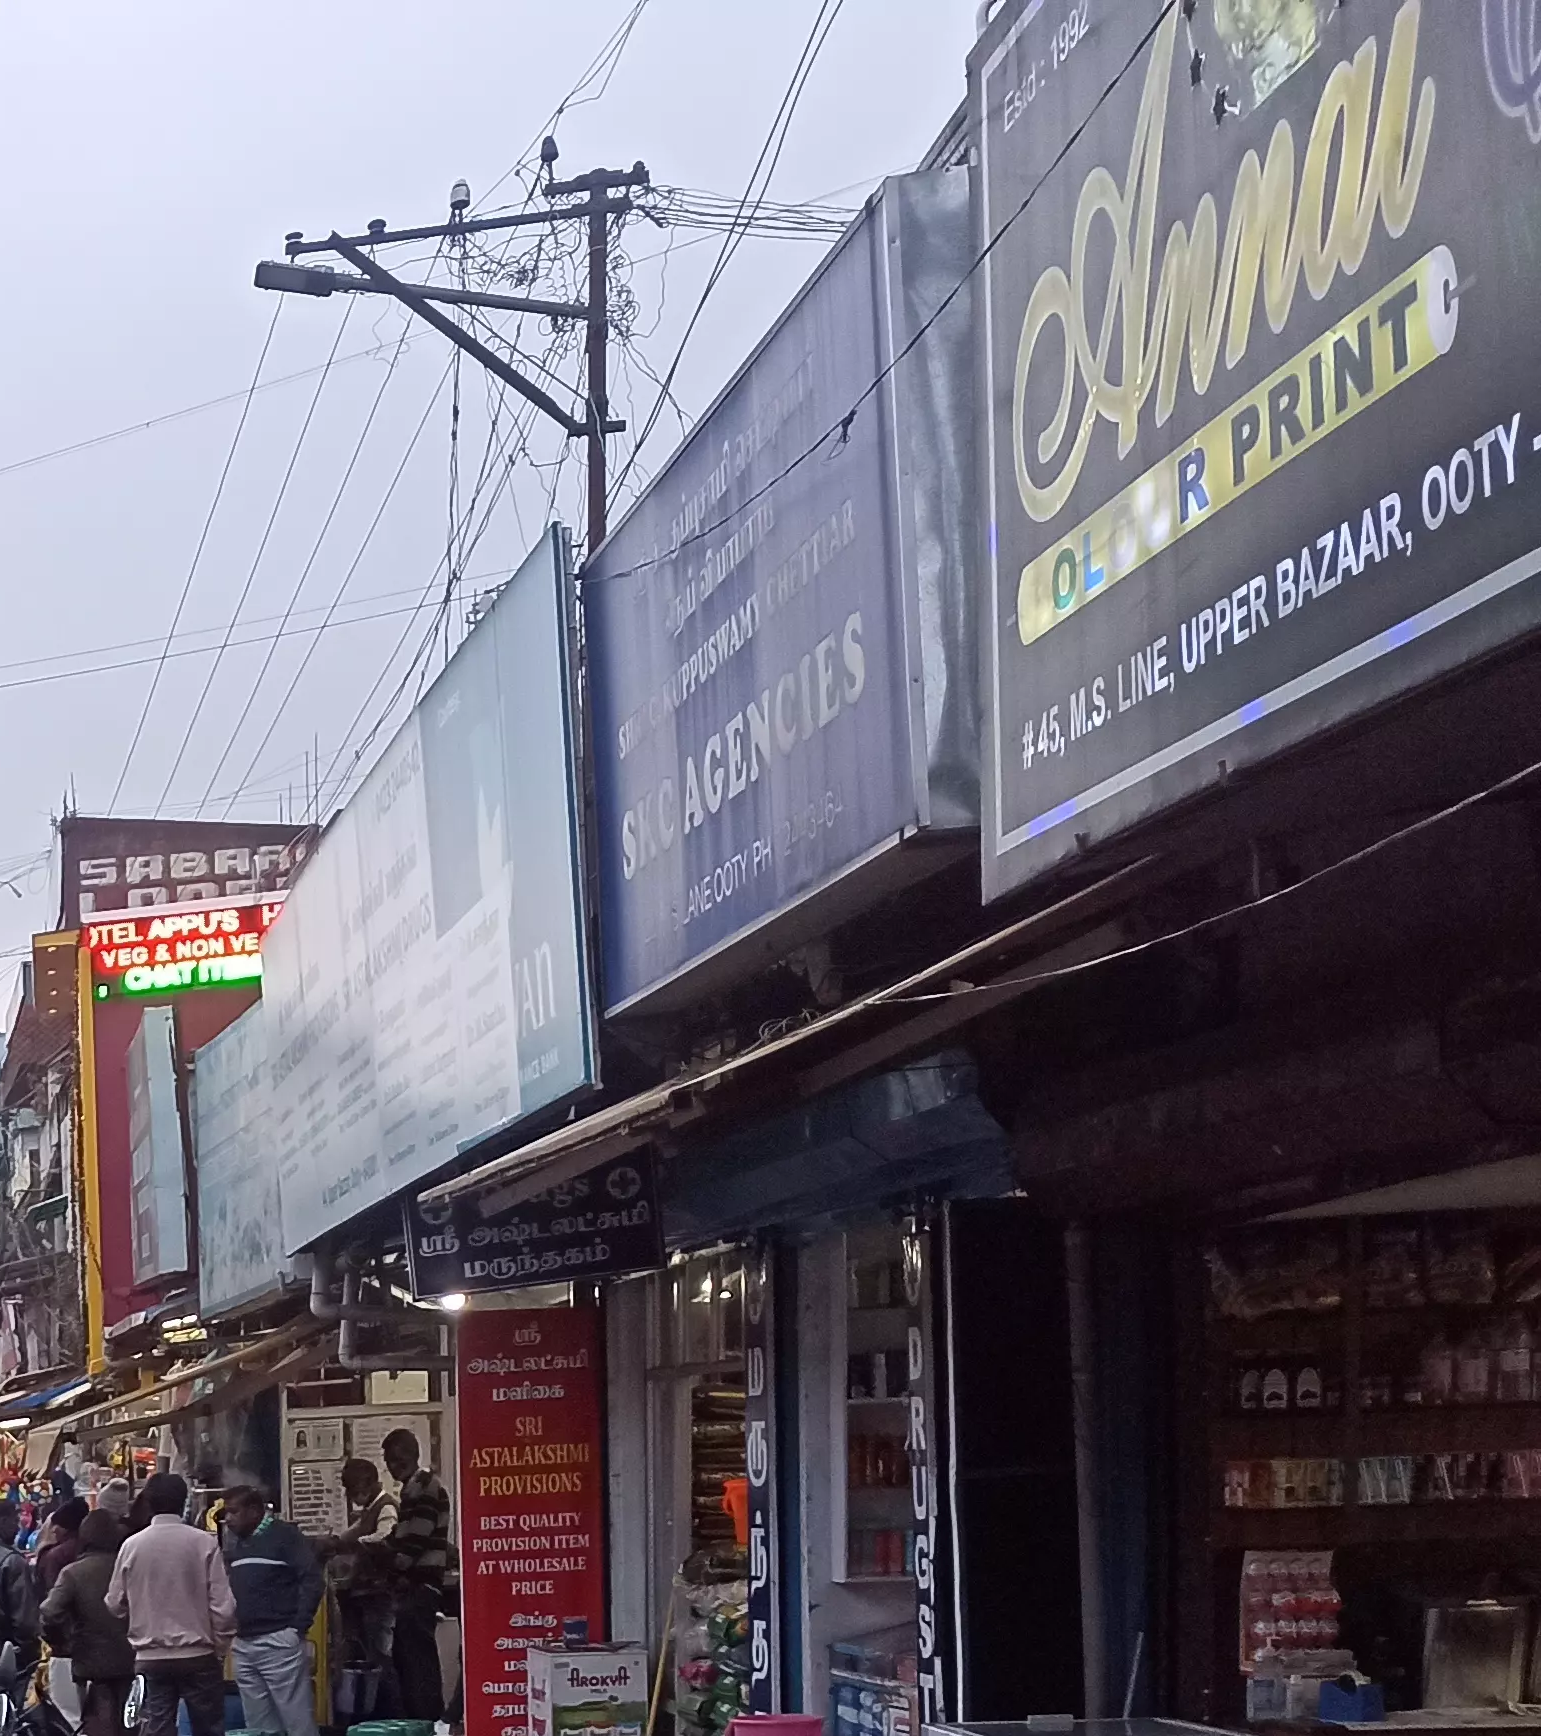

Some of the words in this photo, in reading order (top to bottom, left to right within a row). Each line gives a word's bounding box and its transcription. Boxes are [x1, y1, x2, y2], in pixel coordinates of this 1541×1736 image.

[1049, 5, 1089, 71] 1992
[1231, 278, 1418, 486] PRINT
[1069, 677, 1111, 741] M.S.
[1117, 634, 1174, 713] LINE,
[1180, 574, 1269, 674] UPPER
[1276, 490, 1412, 619] BAZAAR,
[1421, 412, 1520, 531] OOTY
[622, 777, 676, 880] SKC
[684, 611, 865, 835] AGENCIES
[715, 849, 748, 902] OOTY
[752, 837, 772, 877] PH
[146, 910, 240, 940] APPU'S
[100, 947, 148, 968] VEG
[155, 943, 171, 961] &
[175, 936, 224, 959] NON
[419, 1226, 460, 1256] ஸ்ரீ
[467, 1202, 650, 1246] அஷ்டலட்சுமி
[463, 1238, 611, 1279] மருந்தகம்
[467, 1349, 589, 1376] அஷ்டலட்சுமி
[492, 1382, 565, 1401] மளிகை
[515, 1417, 543, 1437] SRI
[469, 1443, 590, 1469] ASTALAKSHMI
[479, 1472, 582, 1498] PROVISIONS
[480, 1515, 516, 1530] BEST
[519, 1512, 581, 1530] QUALITY
[473, 1536, 550, 1552] PROVISION
[554, 1534, 590, 1550] ITEM
[477, 1559, 495, 1574] AT
[499, 1557, 586, 1573] WHOLESALE
[511, 1580, 554, 1595] PRICE
[567, 1666, 630, 1687] AROKYA
